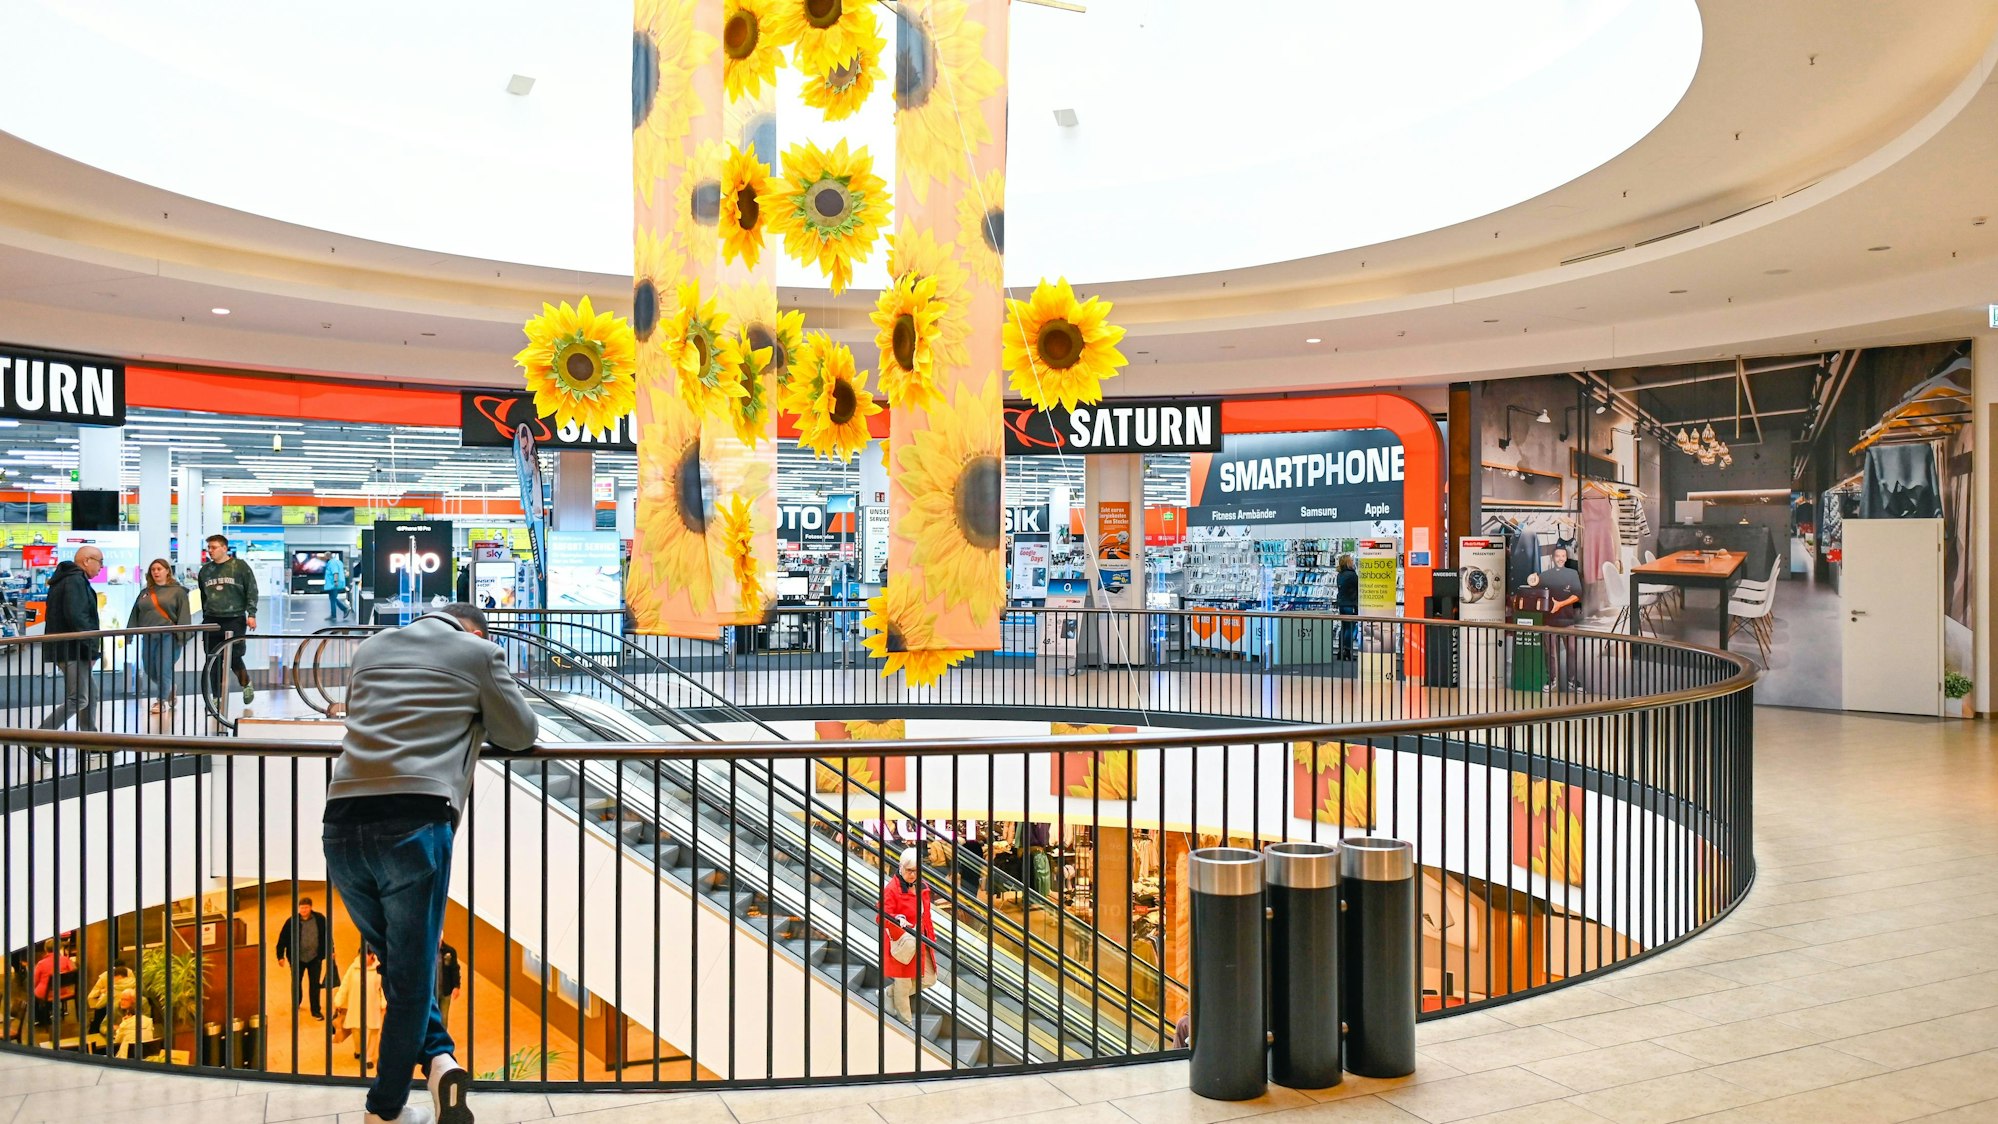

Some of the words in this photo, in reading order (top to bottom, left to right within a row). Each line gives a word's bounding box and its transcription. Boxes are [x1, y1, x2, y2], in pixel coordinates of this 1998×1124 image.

[1069, 406, 1211, 447] SATURN
[1220, 445, 1404, 493] SMARTPHONE
[1212, 510, 1236, 520] Fitness
[1237, 509, 1277, 519] Armbänder
[1300, 506, 1338, 519] Samsung
[1364, 502, 1390, 517] Apple
[486, 550, 503, 559] sky
[390, 552, 440, 573] PRO
[1374, 560, 1386, 569] 50
[1386, 560, 1394, 569] €
